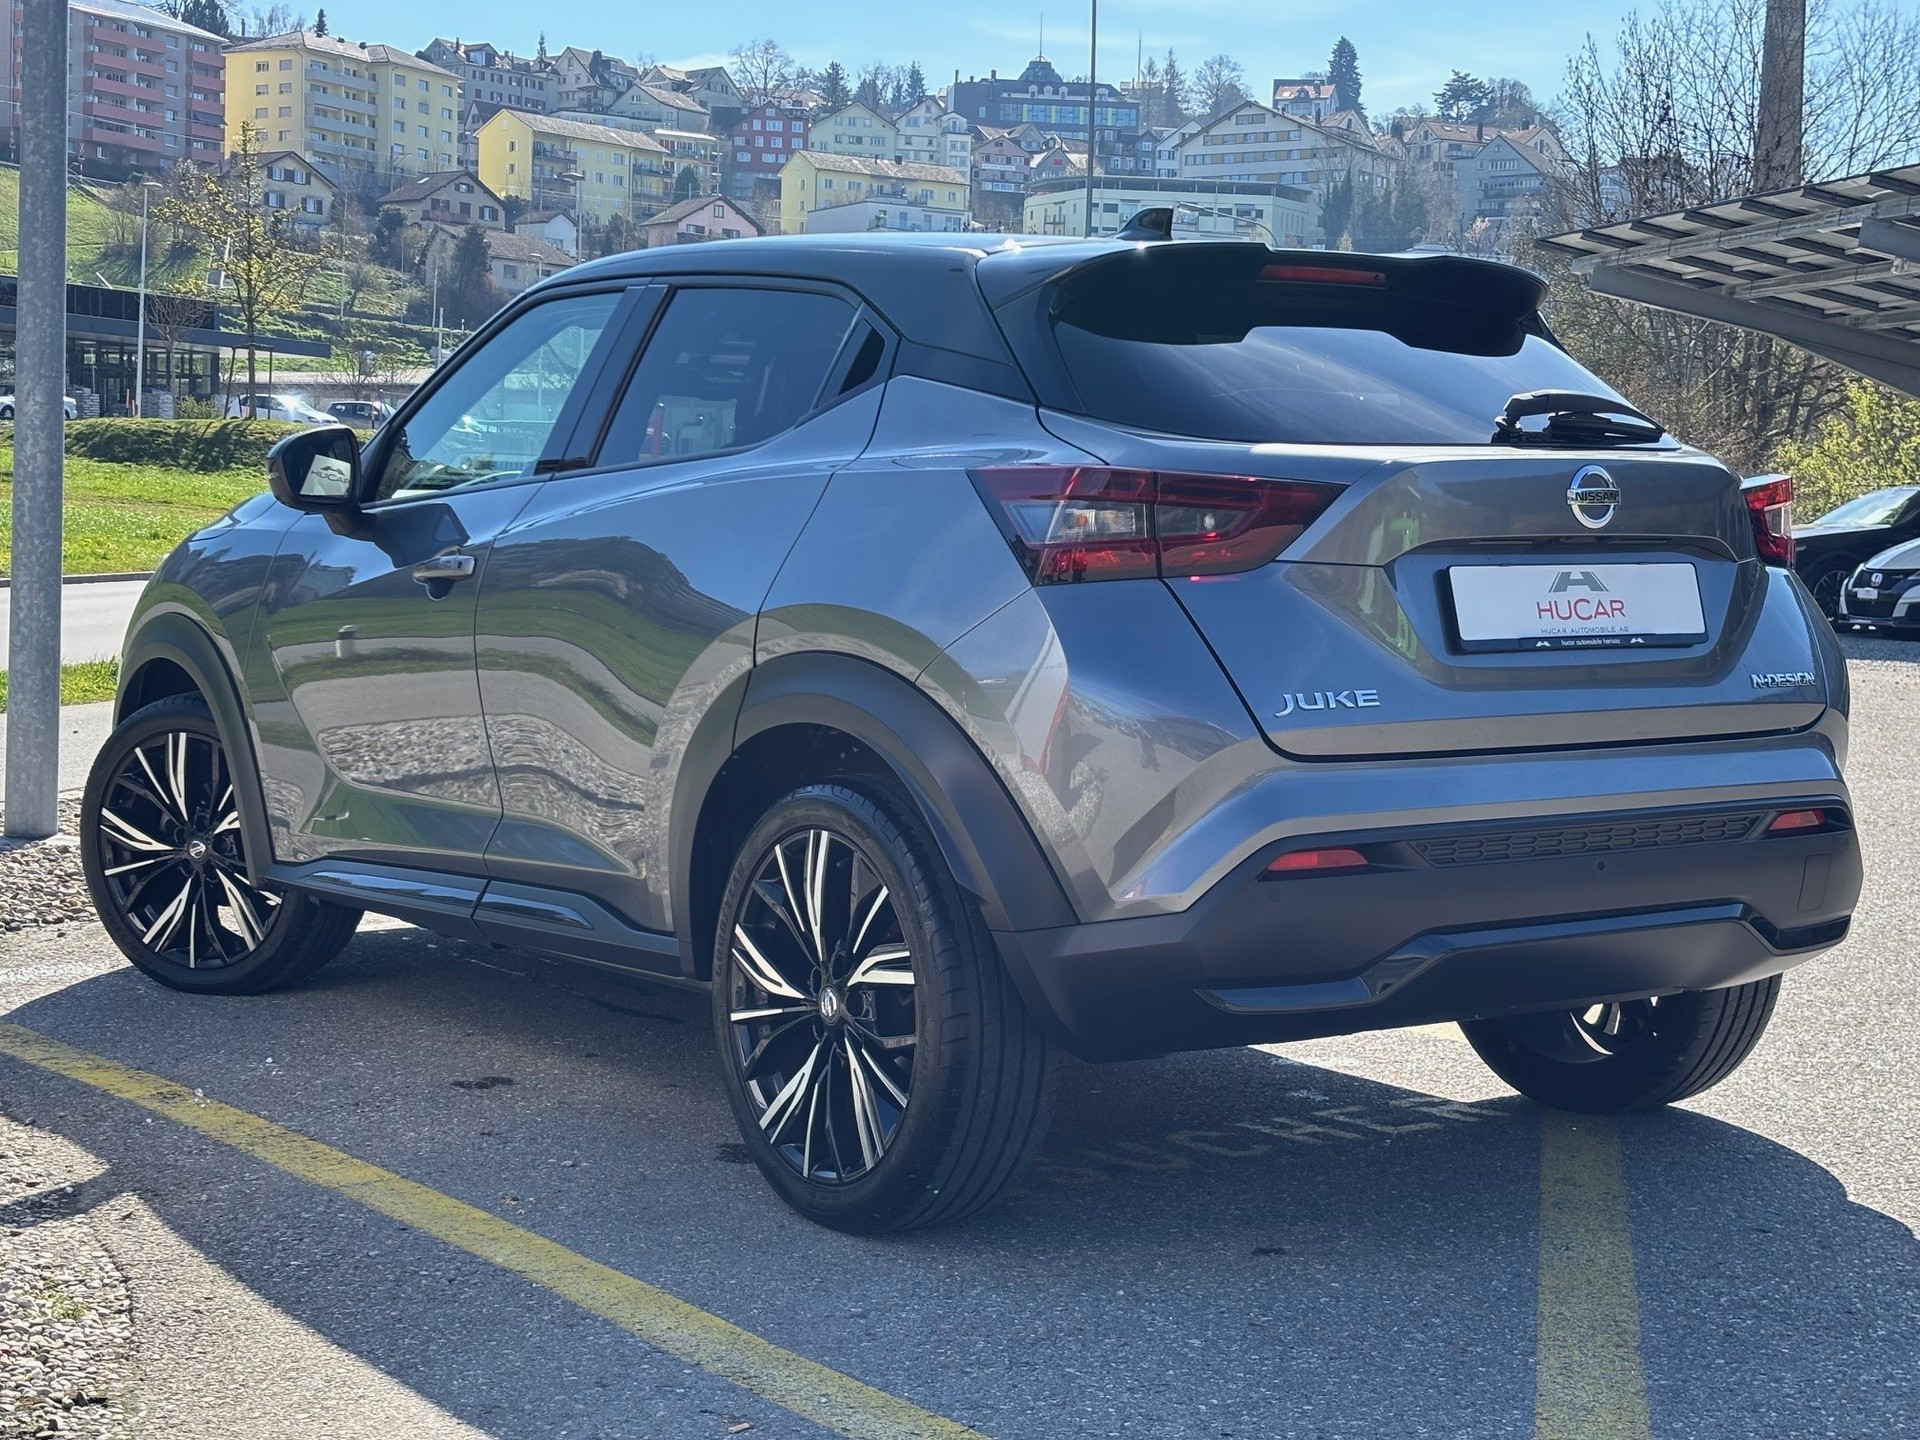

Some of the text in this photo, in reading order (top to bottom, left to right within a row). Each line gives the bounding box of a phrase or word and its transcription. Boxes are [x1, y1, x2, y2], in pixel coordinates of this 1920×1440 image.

[1575, 491, 1617, 501] NISSAN
[1536, 598, 1626, 621] HUCAR
[1541, 625, 1629, 635] HUCAR AUTOMOBILE AG
[1576, 637, 1603, 646] automobile
[1750, 671, 1816, 689] N-DESIGN
[1274, 689, 1381, 718] JUKE
[714, 861, 745, 978] GOODYEAR
